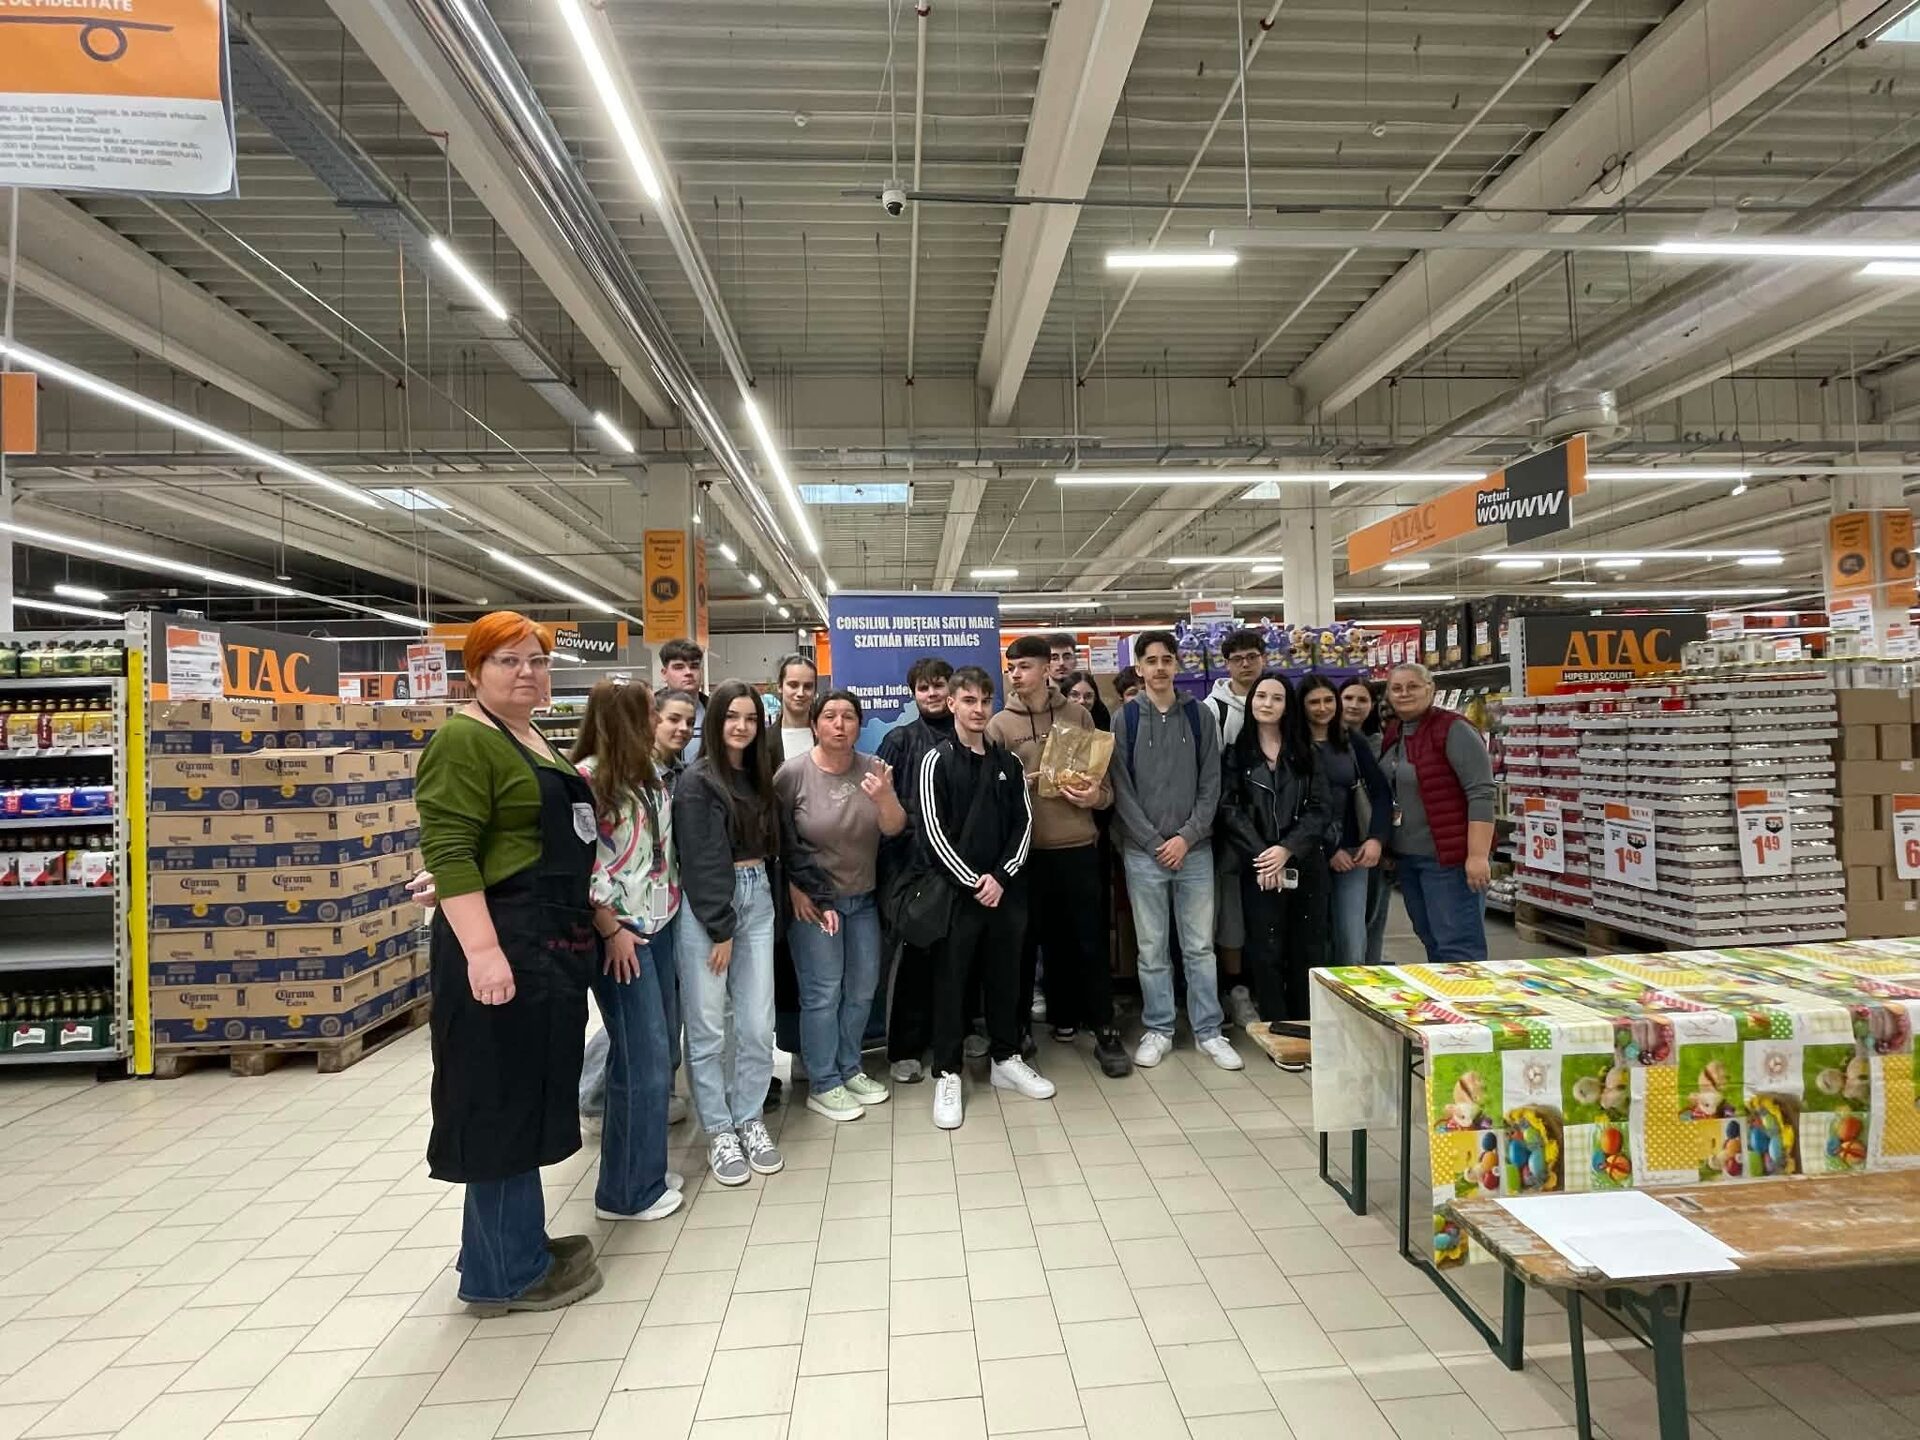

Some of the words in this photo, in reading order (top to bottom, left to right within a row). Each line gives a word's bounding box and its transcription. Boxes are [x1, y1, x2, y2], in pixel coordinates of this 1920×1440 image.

[1390, 503, 1436, 545] ATAC
[836, 616, 891, 630] CONSILIUL
[942, 616, 967, 629] SATU
[968, 616, 995, 629] MARE
[854, 632, 902, 648] SZATMÁR
[904, 634, 940, 647] MEGYEI
[942, 631, 980, 647] TANÁCS
[1562, 628, 1672, 669] ATAC
[1564, 672, 1589, 680] HIPER
[1590, 671, 1633, 680] DISCOUNT
[873, 698, 899, 709] Mare
